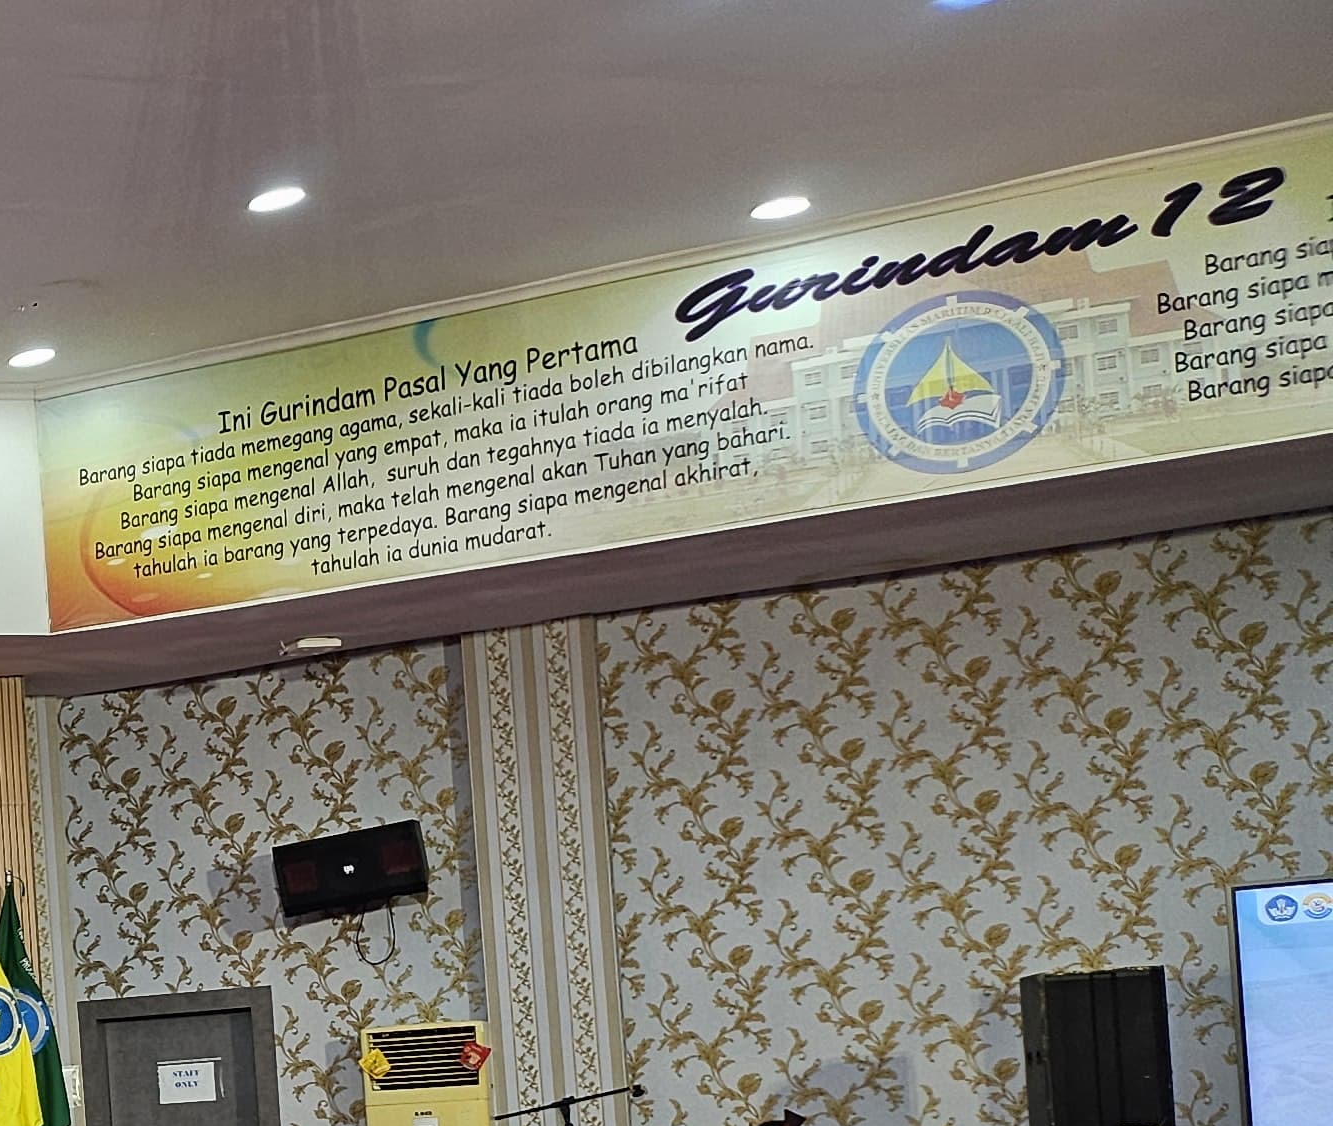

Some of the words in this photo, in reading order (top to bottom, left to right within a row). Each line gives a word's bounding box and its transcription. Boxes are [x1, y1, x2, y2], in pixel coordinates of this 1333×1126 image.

[675, 207, 1139, 342] Gurindam
[1150, 166, 1287, 238] 12
[1157, 287, 1238, 314] Barang
[1247, 276, 1310, 300] siapa
[1205, 246, 1286, 275] Barang
[1295, 236, 1333, 260] sia
[1174, 345, 1256, 373] Barang
[1265, 335, 1328, 360] siapa
[1184, 313, 1265, 341] Barang
[79, 464, 136, 486] Barang
[141, 455, 186, 476] siapa
[190, 441, 236, 466] tiada
[241, 427, 334, 457] memegang
[339, 414, 403, 442] agama,
[408, 387, 505, 424] sekali-kali
[512, 377, 564, 404] tiada
[569, 365, 625, 393] boleh
[631, 346, 748, 381] dibilangkan
[755, 335, 814, 358] nama.
[217, 405, 251, 435] Ini
[260, 386, 376, 426] Gurindam
[384, 364, 446, 402] Pasal
[454, 359, 517, 388] Yang
[526, 336, 639, 374] Pertama
[1188, 374, 1270, 402] Barang
[95, 538, 153, 560] Barang
[157, 529, 202, 551] siapa
[207, 508, 288, 541] mengenal
[294, 502, 332, 525] diri,
[338, 493, 386, 518] maka
[390, 482, 440, 509] telah
[446, 463, 535, 499] mengenal
[541, 460, 588, 482] akan
[593, 448, 657, 472] Tuhan
[661, 440, 710, 467] yang
[716, 412, 791, 451] bahari.
[120, 508, 179, 530] Barang
[184, 499, 229, 521] siapa
[234, 476, 315, 510] mengenal
[322, 468, 375, 494] Allah,
[386, 455, 440, 483] suruh
[446, 450, 481, 471] dan
[486, 435, 577, 466] tegahnya
[582, 420, 636, 447] tiada
[642, 420, 660, 436] ia
[666, 396, 768, 432] menyalah.
[133, 479, 191, 502] Barang
[196, 470, 242, 492] siapa
[247, 447, 329, 482] mengenal
[334, 445, 378, 471] yang
[383, 429, 448, 457] empat,
[454, 417, 504, 443] maka
[510, 413, 527, 432] ia
[533, 399, 590, 428] itulah
[596, 393, 653, 416] orang
[660, 372, 749, 405] ma'rifat
[132, 551, 198, 579] tahulah
[203, 549, 219, 567] ia
[223, 542, 284, 564] barang
[289, 533, 331, 558] yang
[336, 515, 438, 545] terpedaya.
[445, 502, 511, 526] Barang
[517, 493, 568, 515] siapa
[574, 469, 667, 505] mengenal
[674, 454, 758, 487] akhirat,
[310, 547, 380, 576] tahulah
[386, 544, 403, 563] ia
[408, 535, 459, 559] dunia
[465, 520, 553, 551] mudarat.
